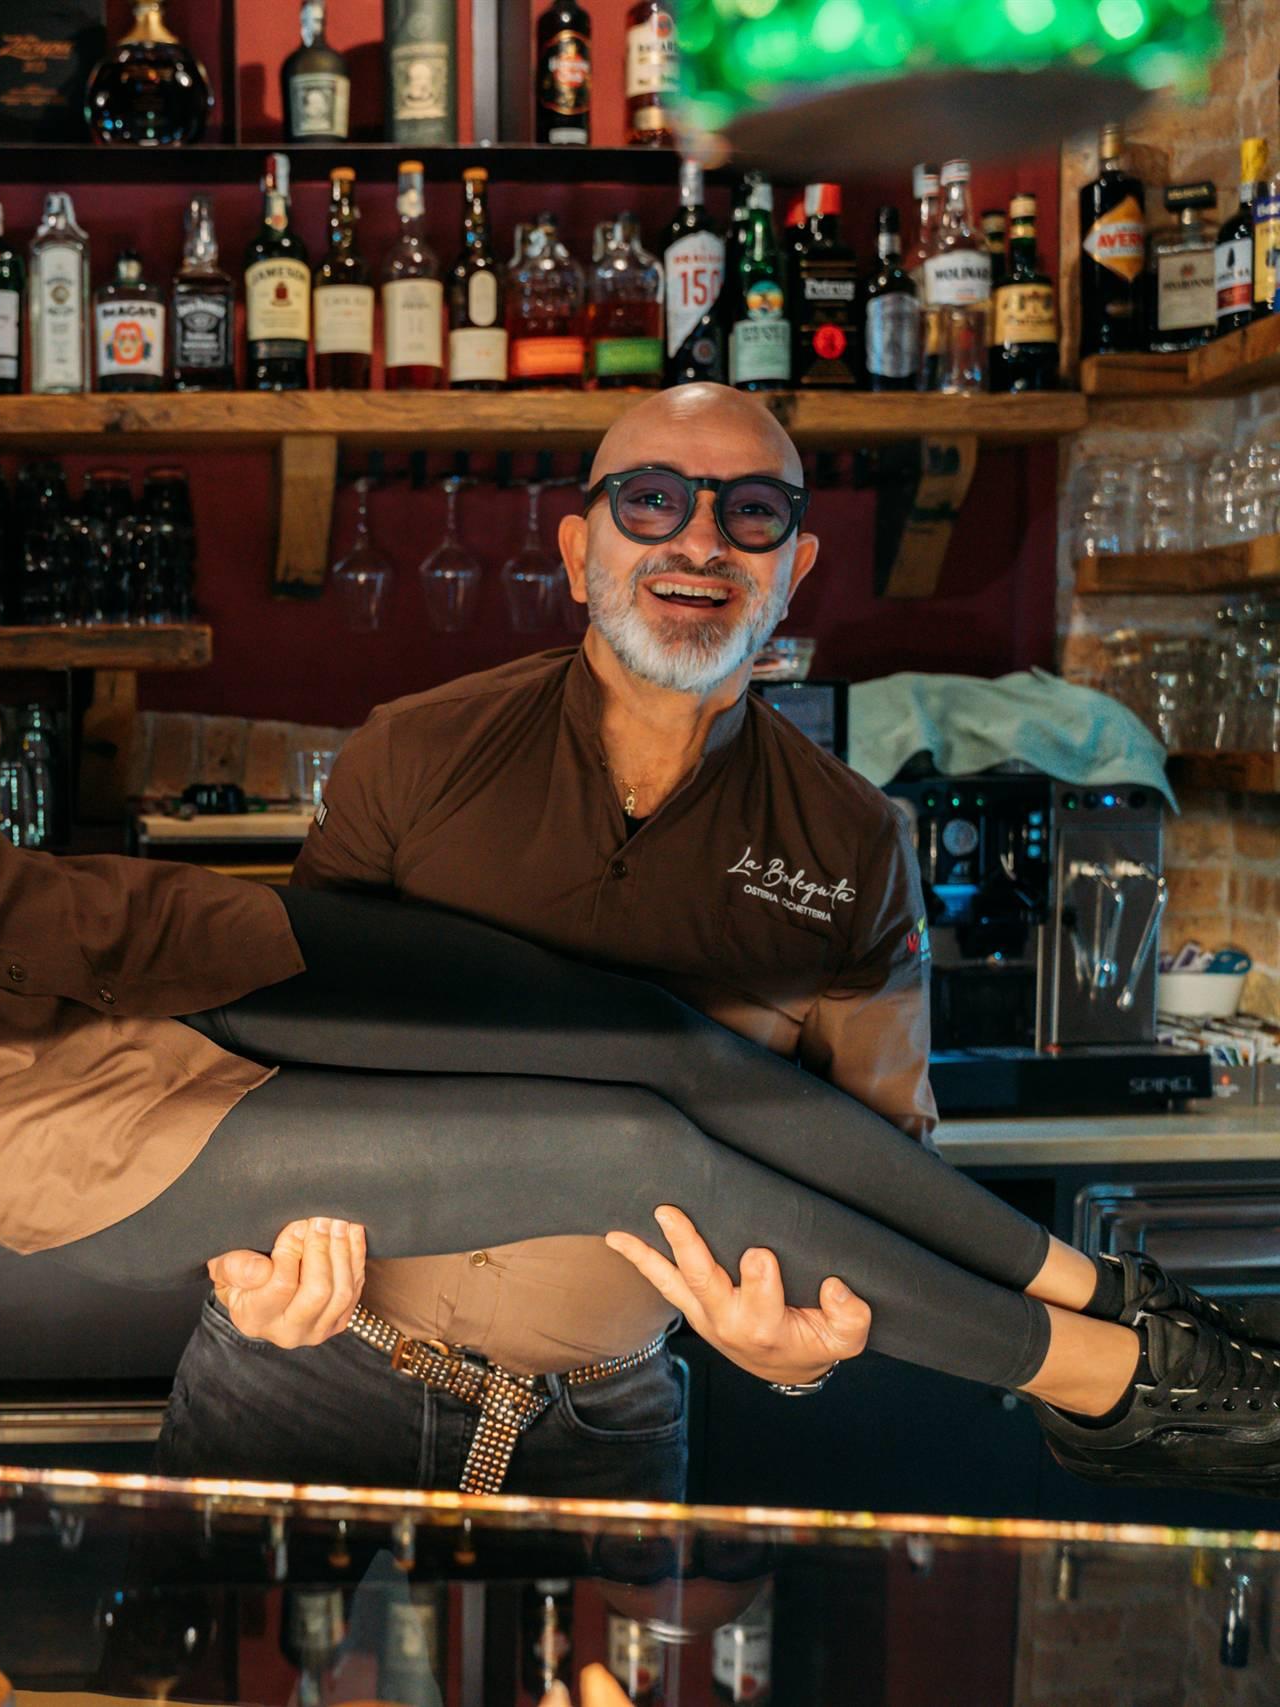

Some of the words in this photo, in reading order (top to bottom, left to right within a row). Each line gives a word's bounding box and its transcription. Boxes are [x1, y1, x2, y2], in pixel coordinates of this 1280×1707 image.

[1097, 229, 1144, 249] AVER
[727, 846, 762, 877] La
[743, 884, 779, 903] OSTERIA
